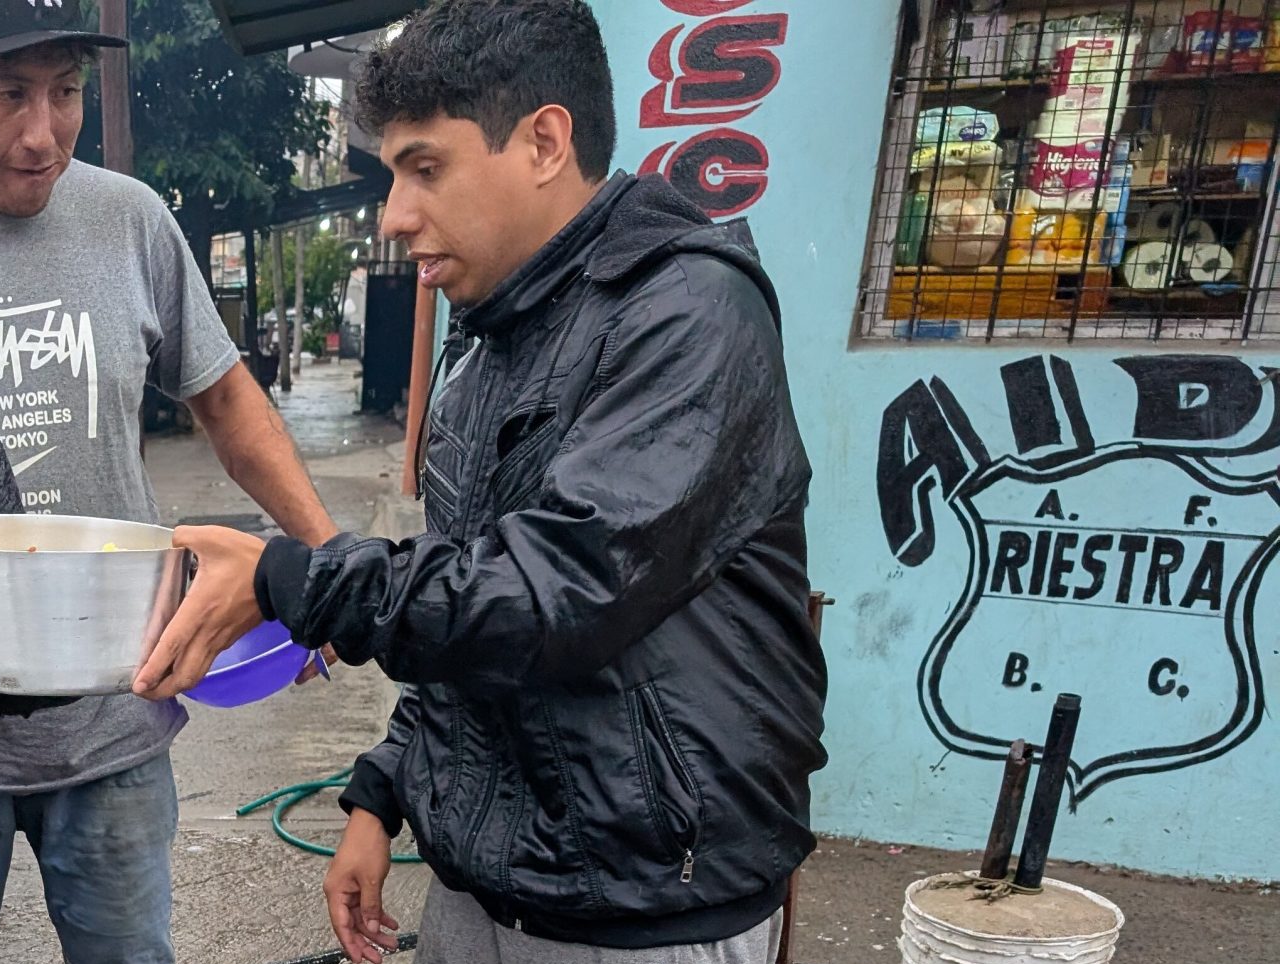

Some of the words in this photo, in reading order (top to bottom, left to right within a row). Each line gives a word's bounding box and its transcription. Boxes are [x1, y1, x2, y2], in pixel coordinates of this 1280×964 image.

[16, 390, 59, 408] YORK
[1, 408, 72, 431] ANGELES
[989, 529, 1226, 612] RIESTRA
